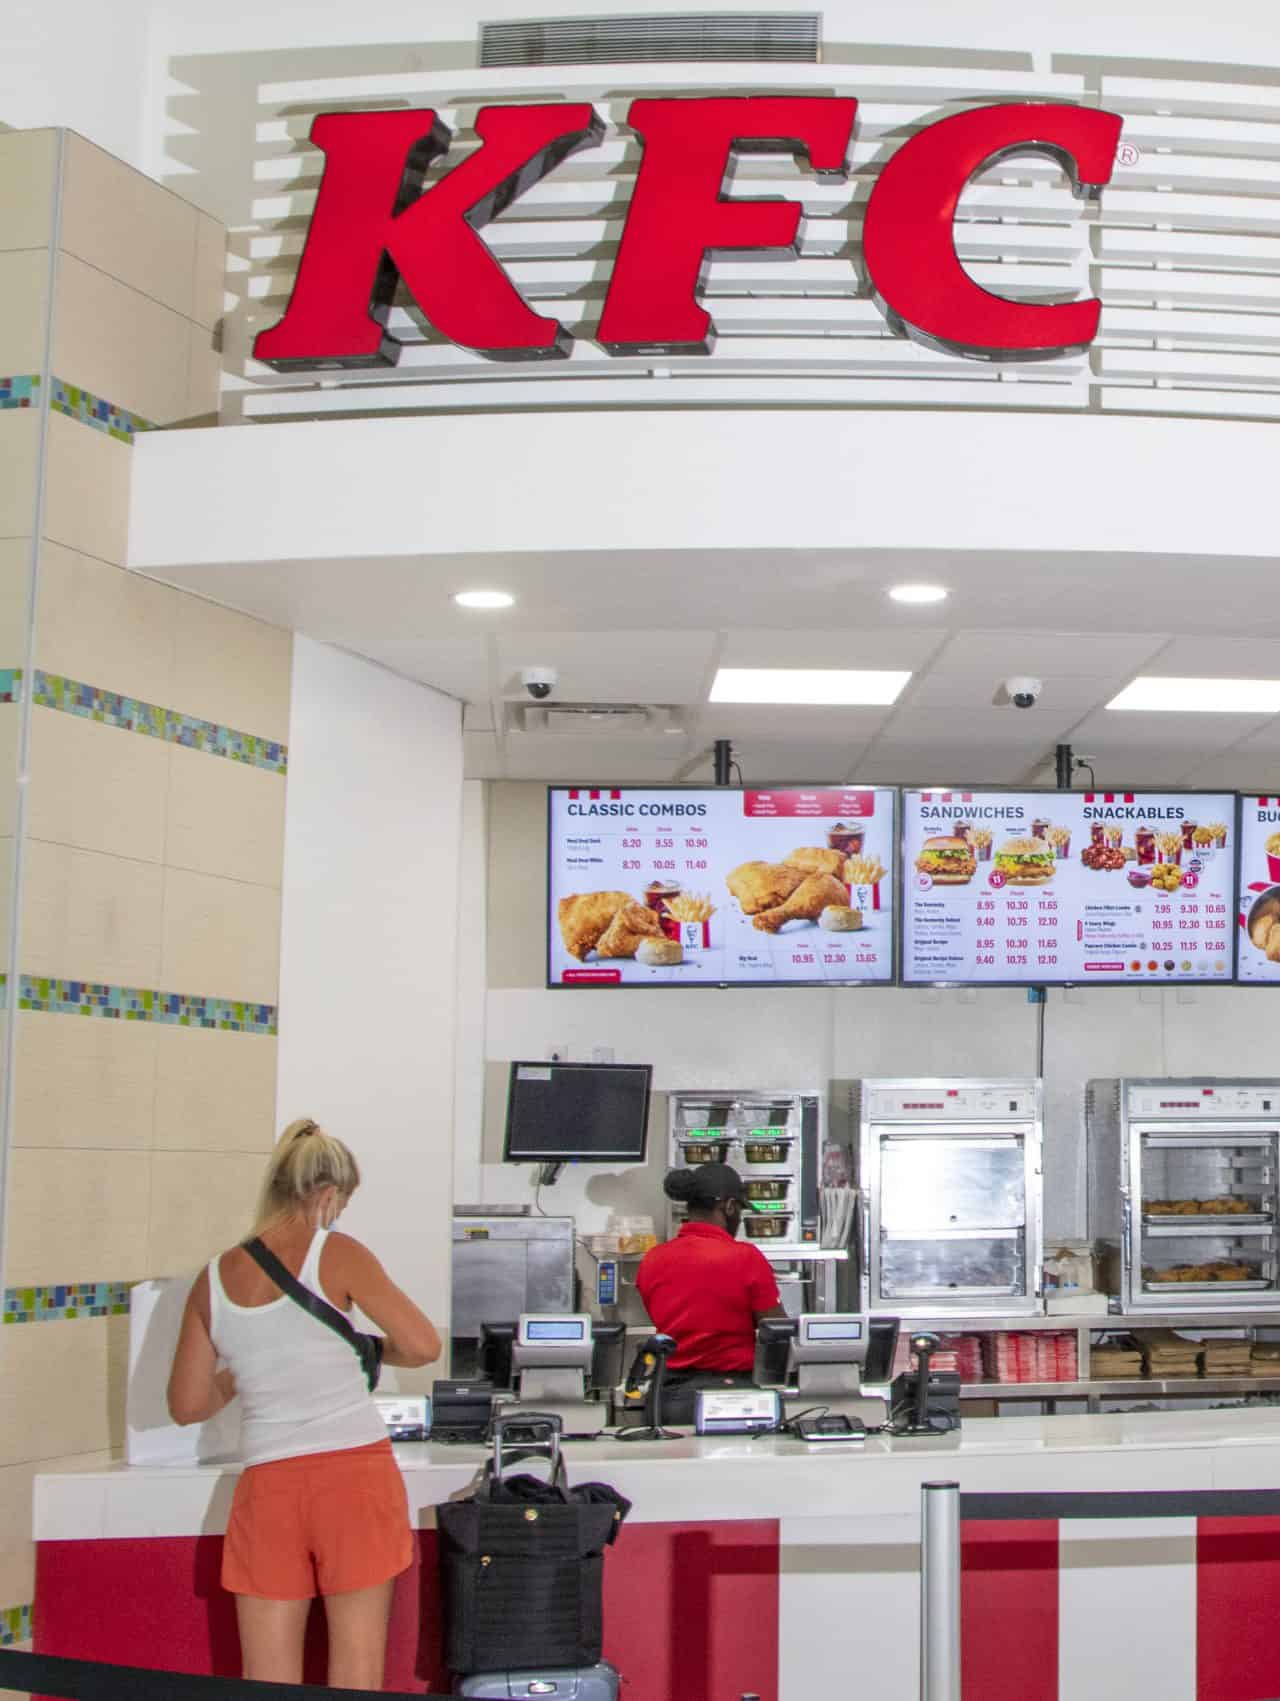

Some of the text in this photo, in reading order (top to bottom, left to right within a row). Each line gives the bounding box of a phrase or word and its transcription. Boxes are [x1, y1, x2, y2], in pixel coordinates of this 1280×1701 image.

[252, 95, 1125, 368] KFC
[567, 803, 707, 817] CLASSIC COMBOS
[920, 806, 1025, 819] SANDWICHES
[1083, 807, 1185, 819] SNACKABLES
[976, 901, 995, 910] 8.95
[1006, 901, 1028, 910] 10.30
[1038, 901, 1058, 910] 11.65
[976, 917, 995, 927] 9.40
[1006, 917, 1028, 927] 10.75
[1038, 917, 1058, 927] 12.10
[976, 939, 995, 949] 8.95
[1006, 939, 1028, 949] 10.30
[1038, 939, 1058, 949] 11.65
[976, 955, 995, 965] 9.40
[1006, 955, 1028, 965] 10.75
[1038, 955, 1058, 965] 12.10
